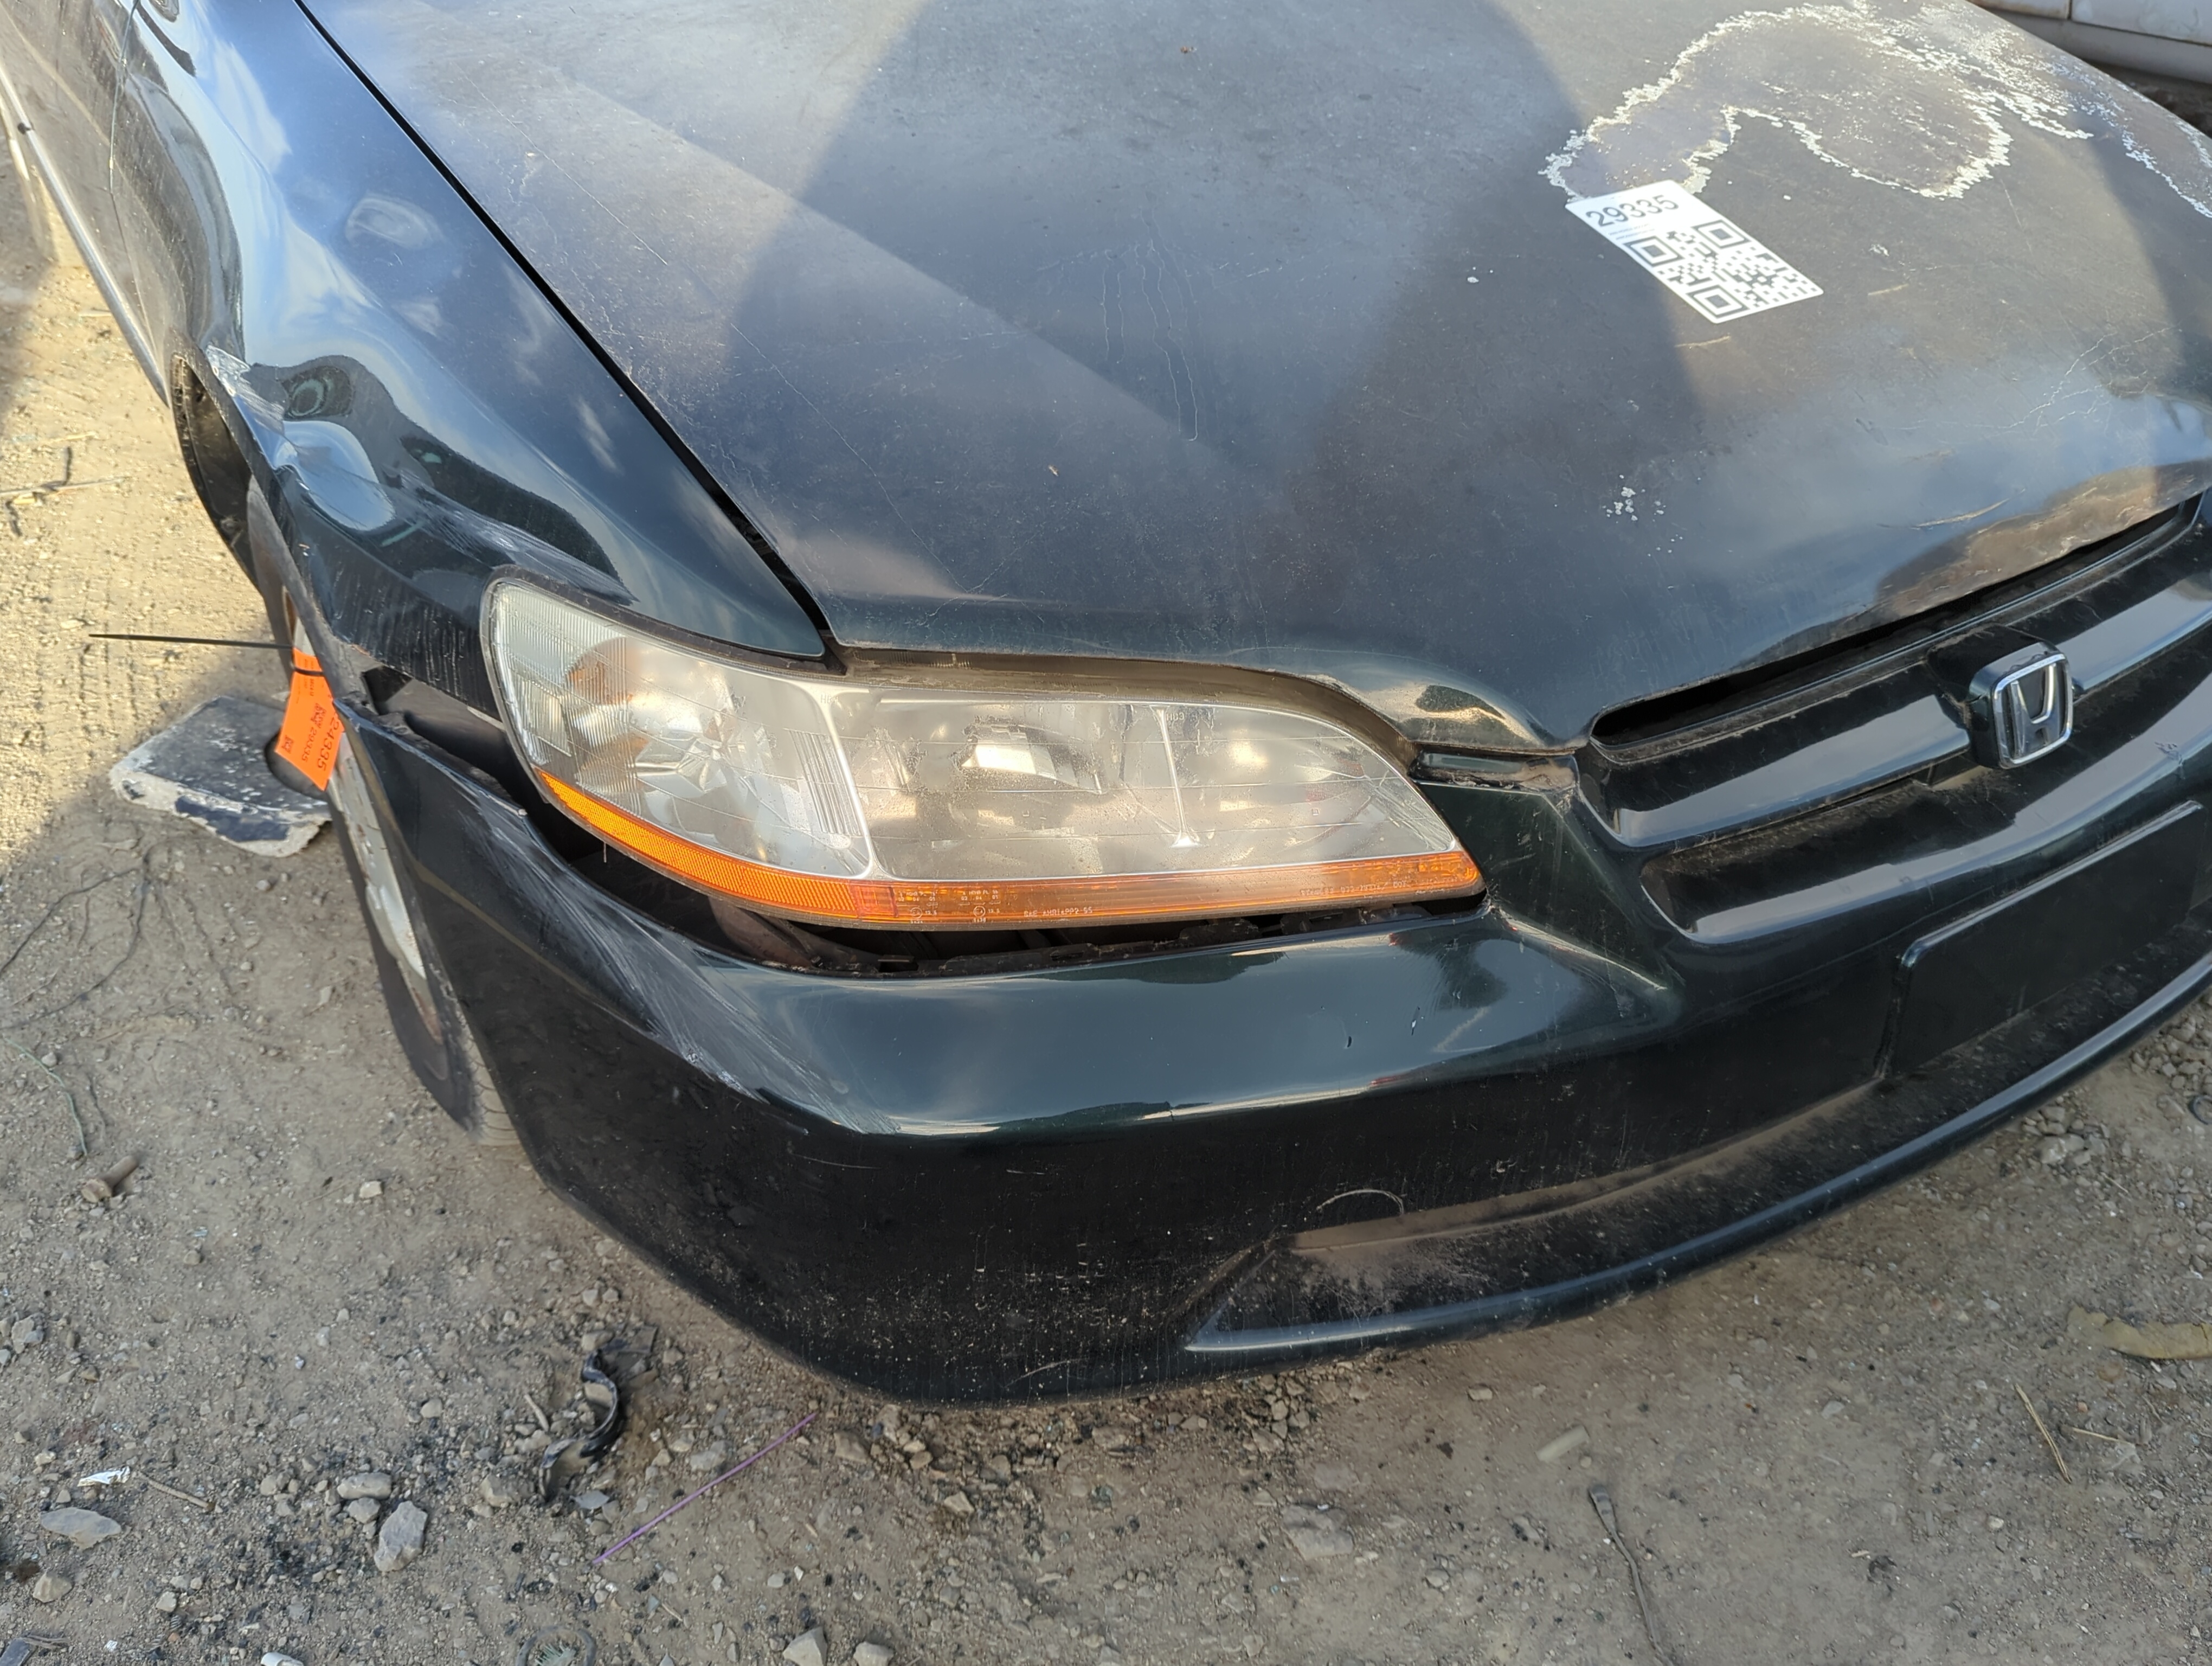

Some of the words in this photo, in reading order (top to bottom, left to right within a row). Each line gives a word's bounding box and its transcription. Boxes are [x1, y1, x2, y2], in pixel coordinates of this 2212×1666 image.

[1586, 195, 1679, 227] 29335
[301, 727, 318, 763] 29335
[317, 712, 340, 771] 24335
